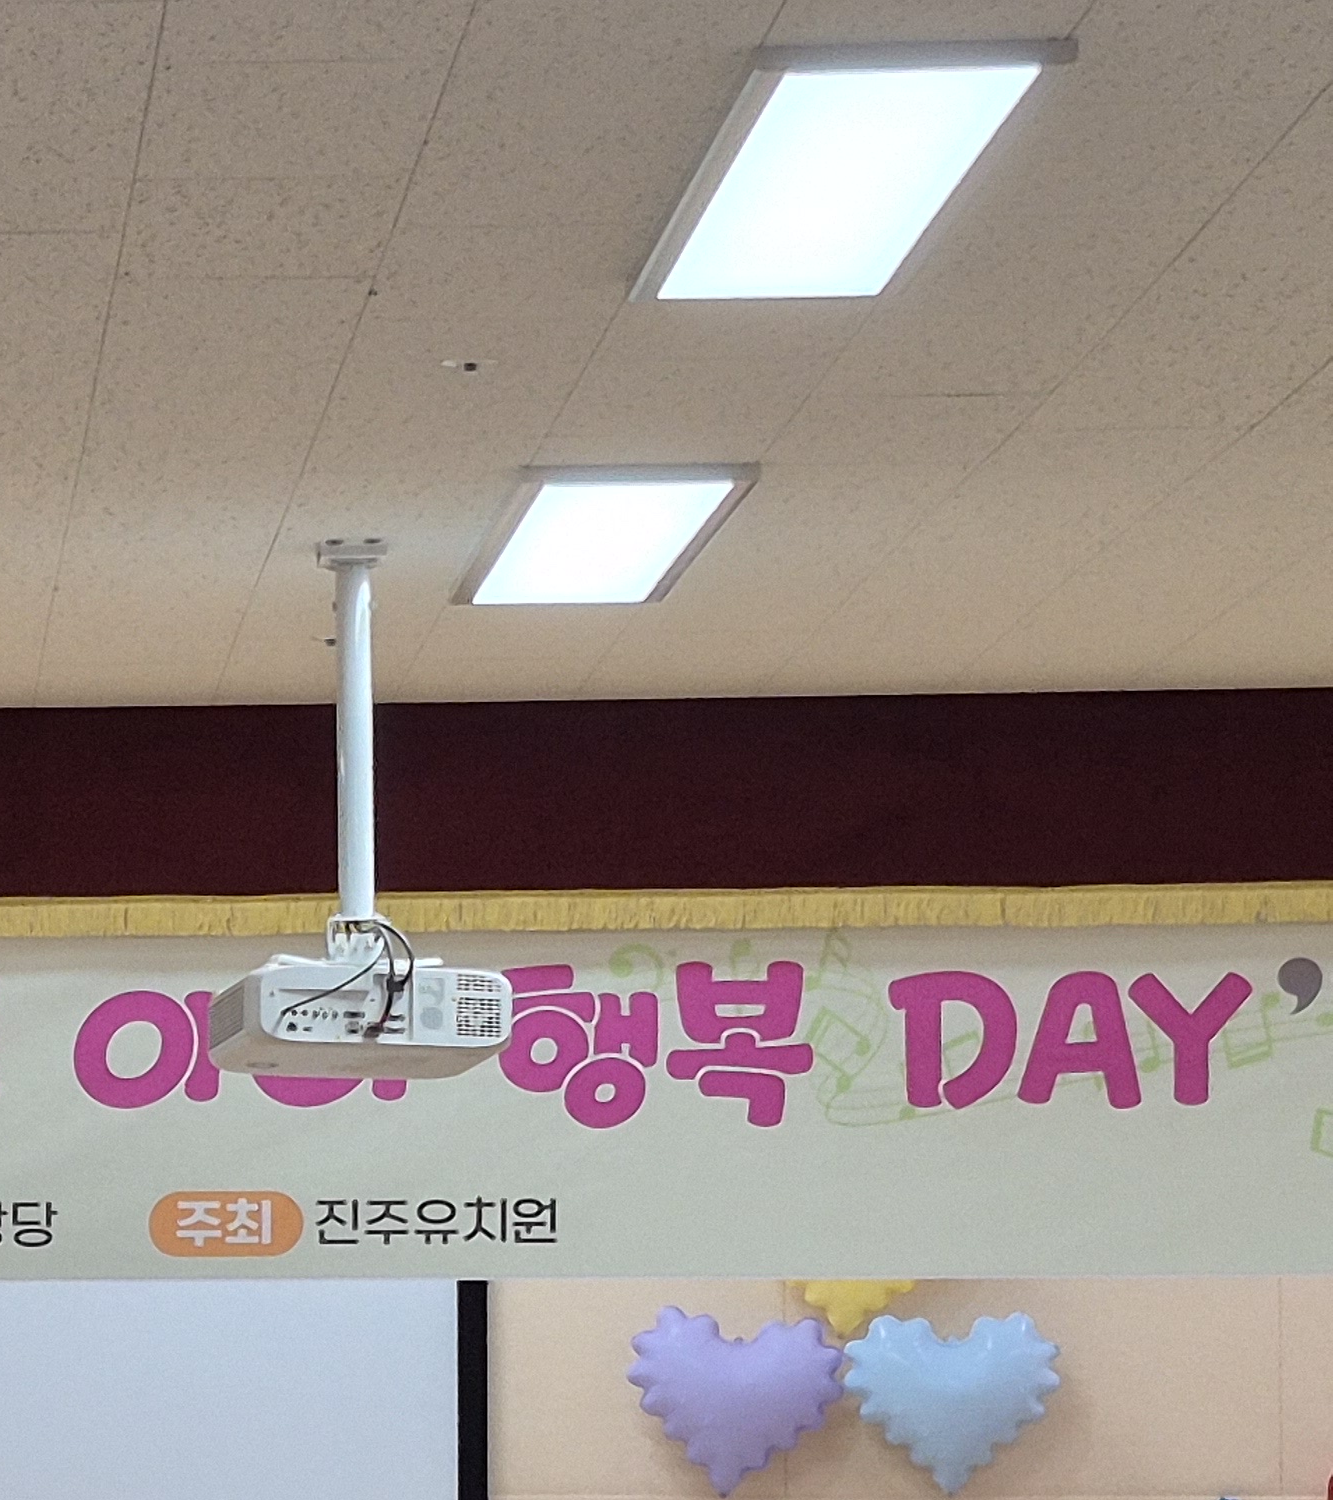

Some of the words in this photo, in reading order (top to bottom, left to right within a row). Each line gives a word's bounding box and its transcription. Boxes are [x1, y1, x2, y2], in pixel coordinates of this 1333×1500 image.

[499, 960, 814, 1128] 행복
[175, 1198, 273, 1247] 주최
[315, 1195, 558, 1245] 진주유치원
